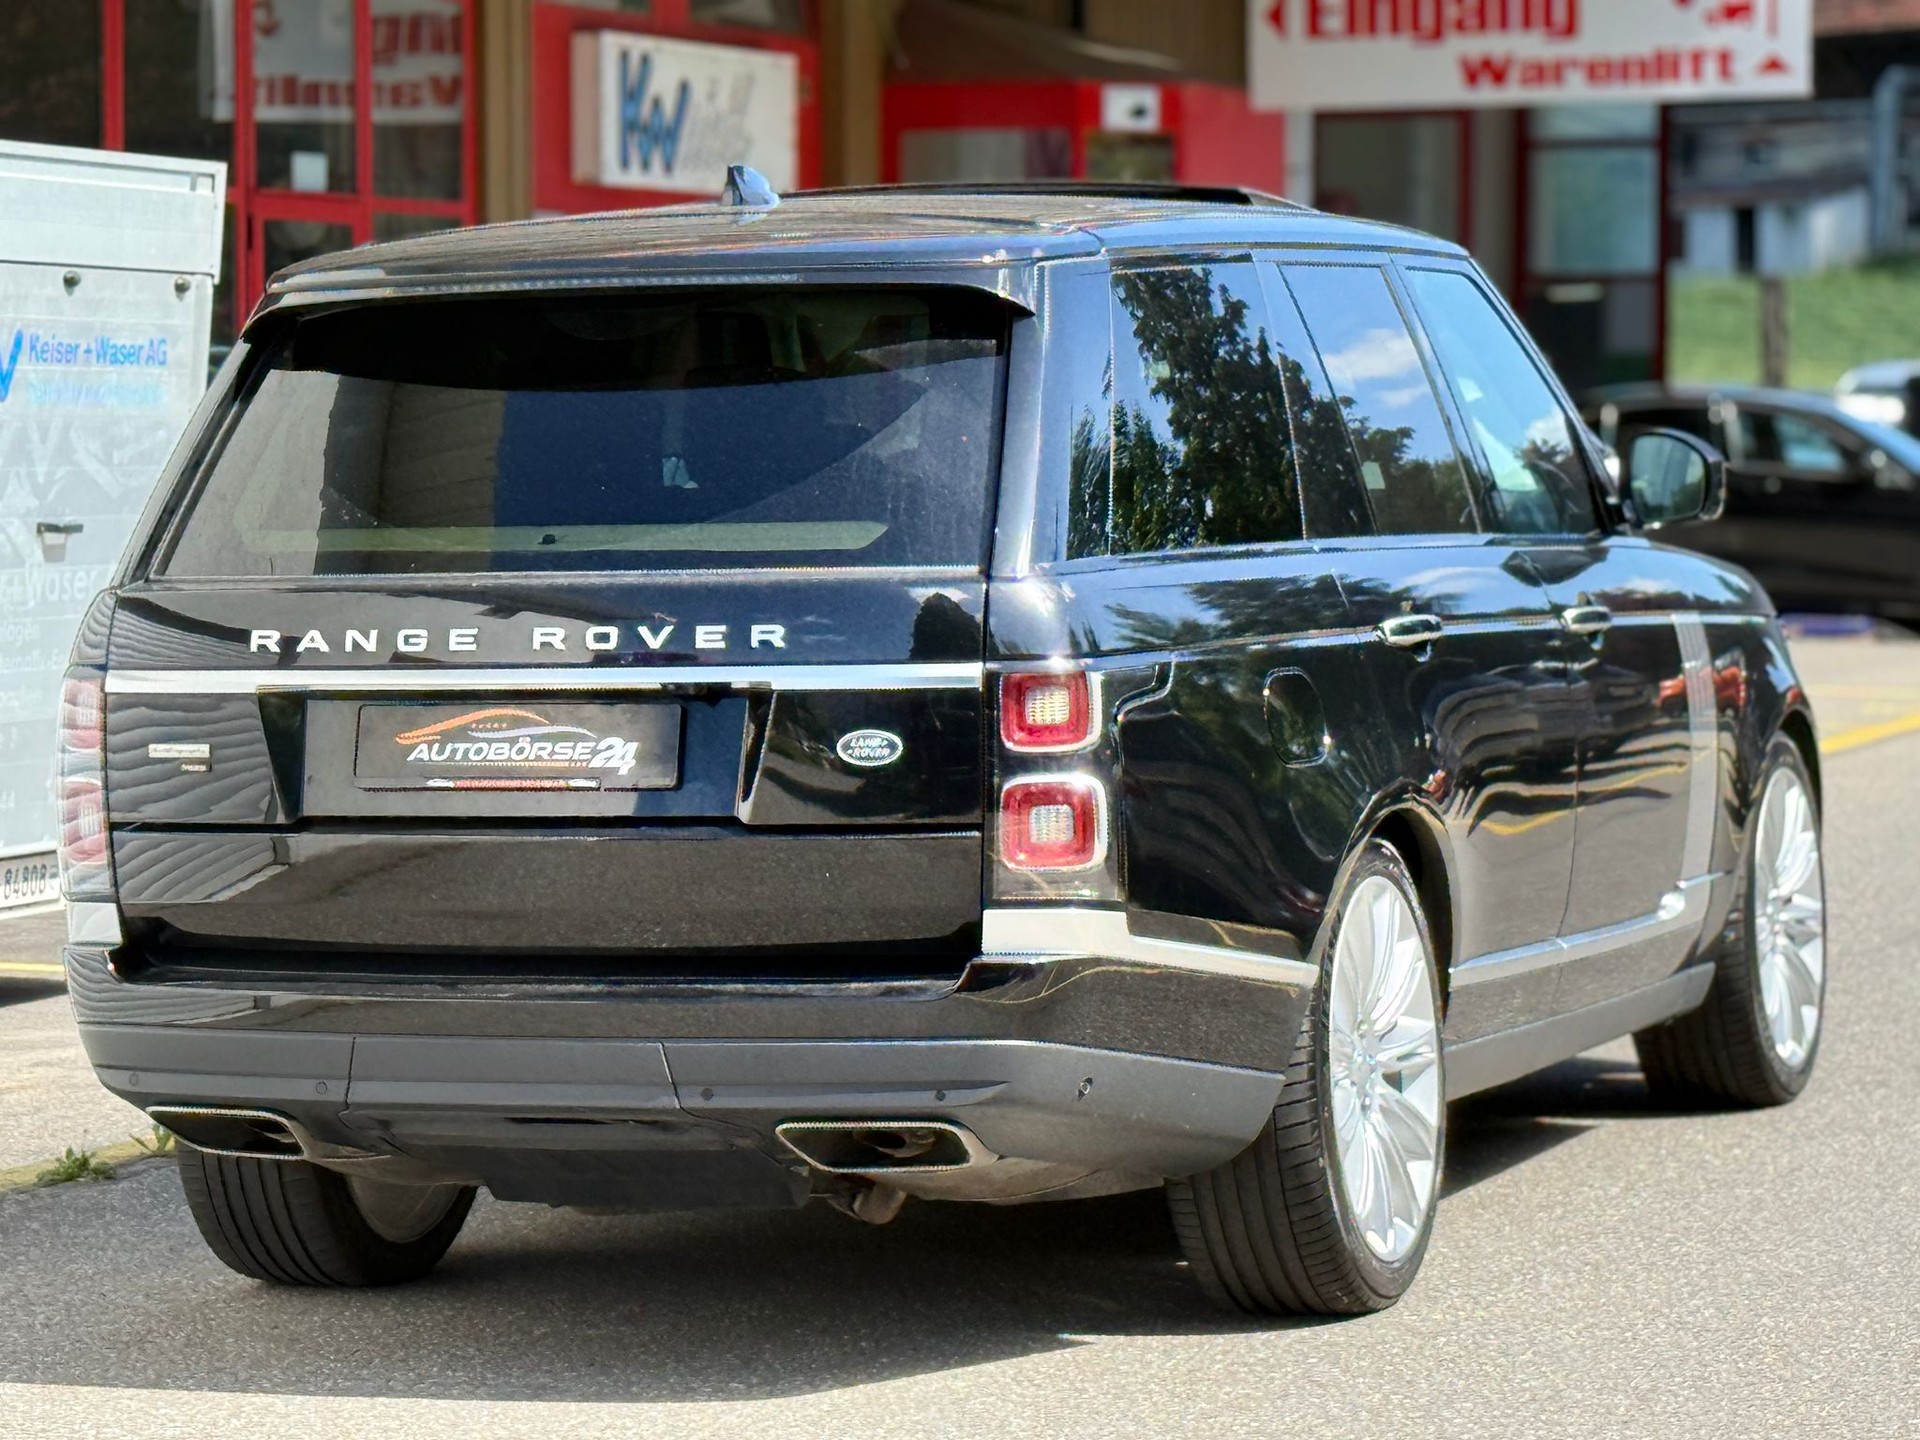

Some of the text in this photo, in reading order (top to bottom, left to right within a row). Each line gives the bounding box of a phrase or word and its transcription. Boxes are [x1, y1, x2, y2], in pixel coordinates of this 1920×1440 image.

[1458, 48, 1735, 89] Warenlift
[28, 333, 80, 364] Keiser
[250, 624, 786, 653] RANGE ROVER
